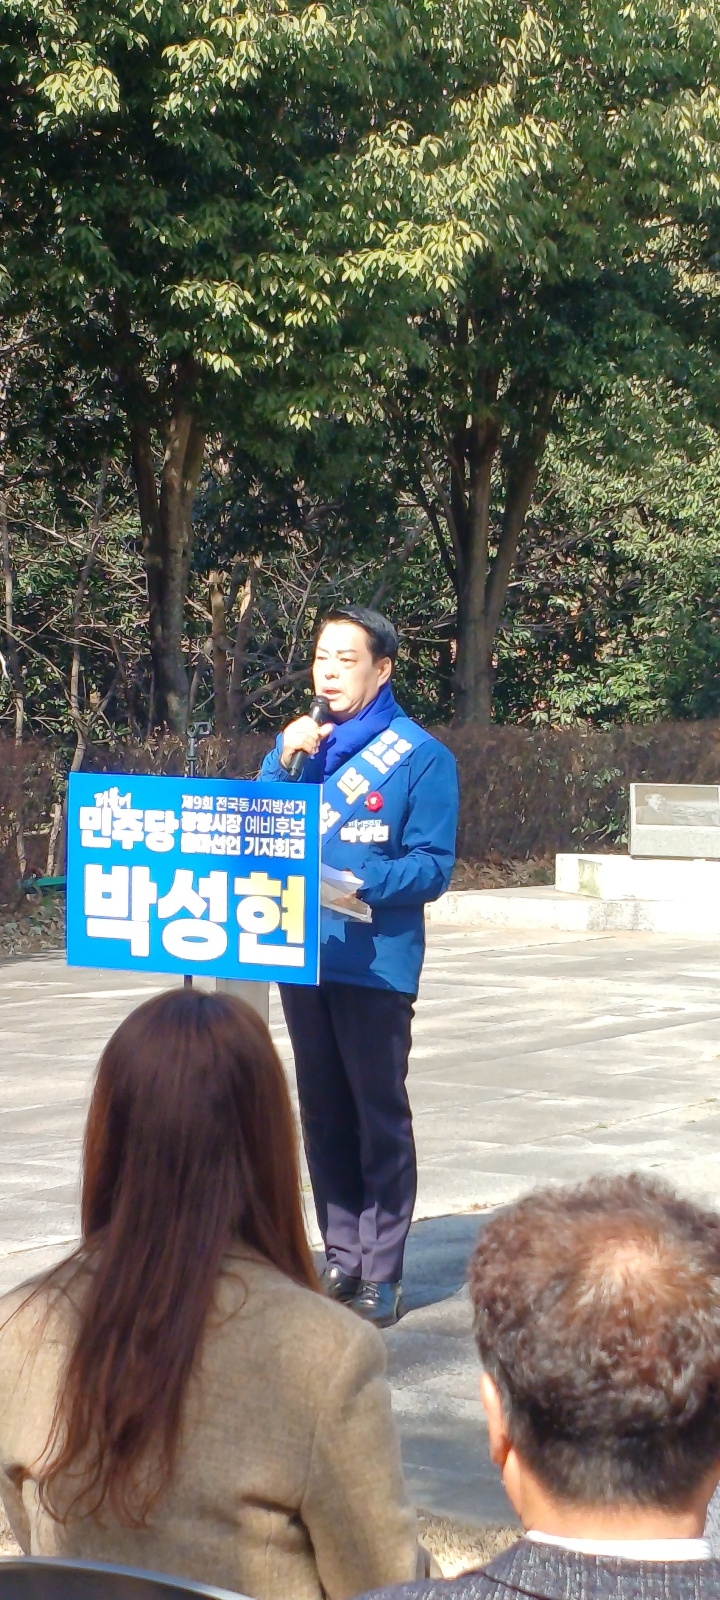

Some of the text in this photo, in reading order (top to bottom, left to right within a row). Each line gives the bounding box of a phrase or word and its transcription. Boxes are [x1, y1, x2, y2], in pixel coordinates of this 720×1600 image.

[181, 794, 306, 815] 제9회 전국동시지방선거
[79, 806, 180, 853] 민주당
[244, 815, 306, 837] 예비후보
[244, 836, 305, 860] 기자회견
[83, 863, 306, 968] 박성현
